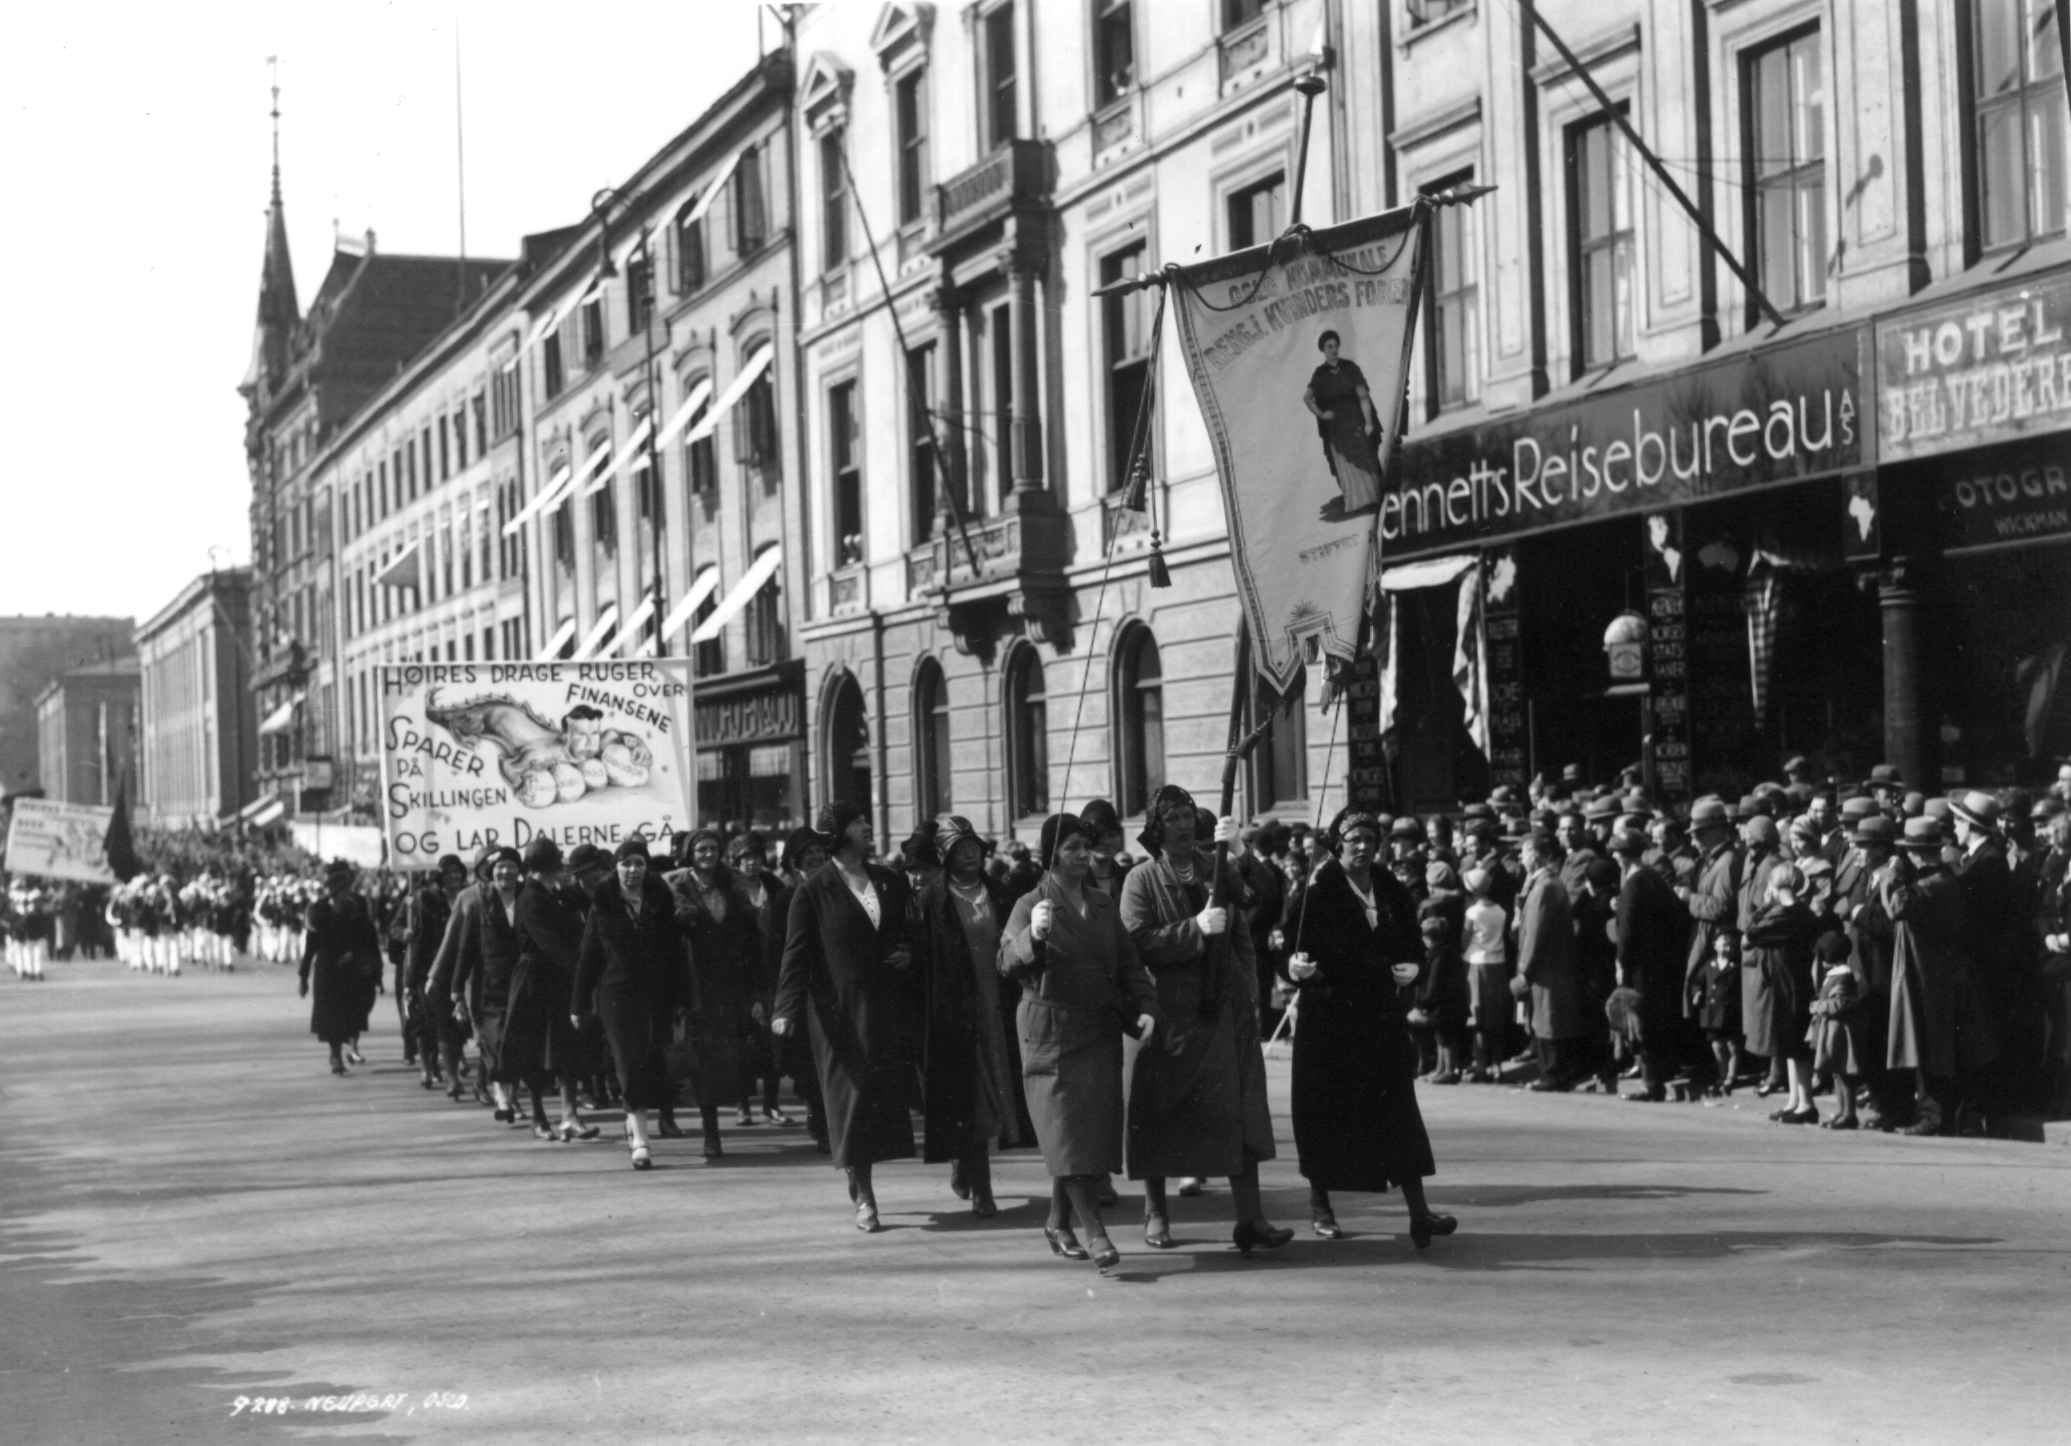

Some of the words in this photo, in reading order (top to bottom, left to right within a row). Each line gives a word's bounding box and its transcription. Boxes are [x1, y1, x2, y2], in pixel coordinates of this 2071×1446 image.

[1904, 300, 2062, 375] HOTEL
[1382, 458, 1509, 541] ennetts
[1513, 388, 1832, 514] Reisebureau
[386, 664, 478, 696] HØIRES
[492, 664, 563, 683] DRAGE
[578, 662, 655, 682] RUGER
[633, 683, 685, 699] OVER
[566, 684, 672, 733] FINANSENE
[387, 715, 485, 778] SPARER
[397, 757, 424, 778] PÅ
[389, 783, 507, 819] SKILLINGEN
[395, 831, 440, 854] OG
[456, 826, 499, 852] LAR
[514, 817, 621, 849] DALERNE
[637, 814, 674, 842] GÅ
